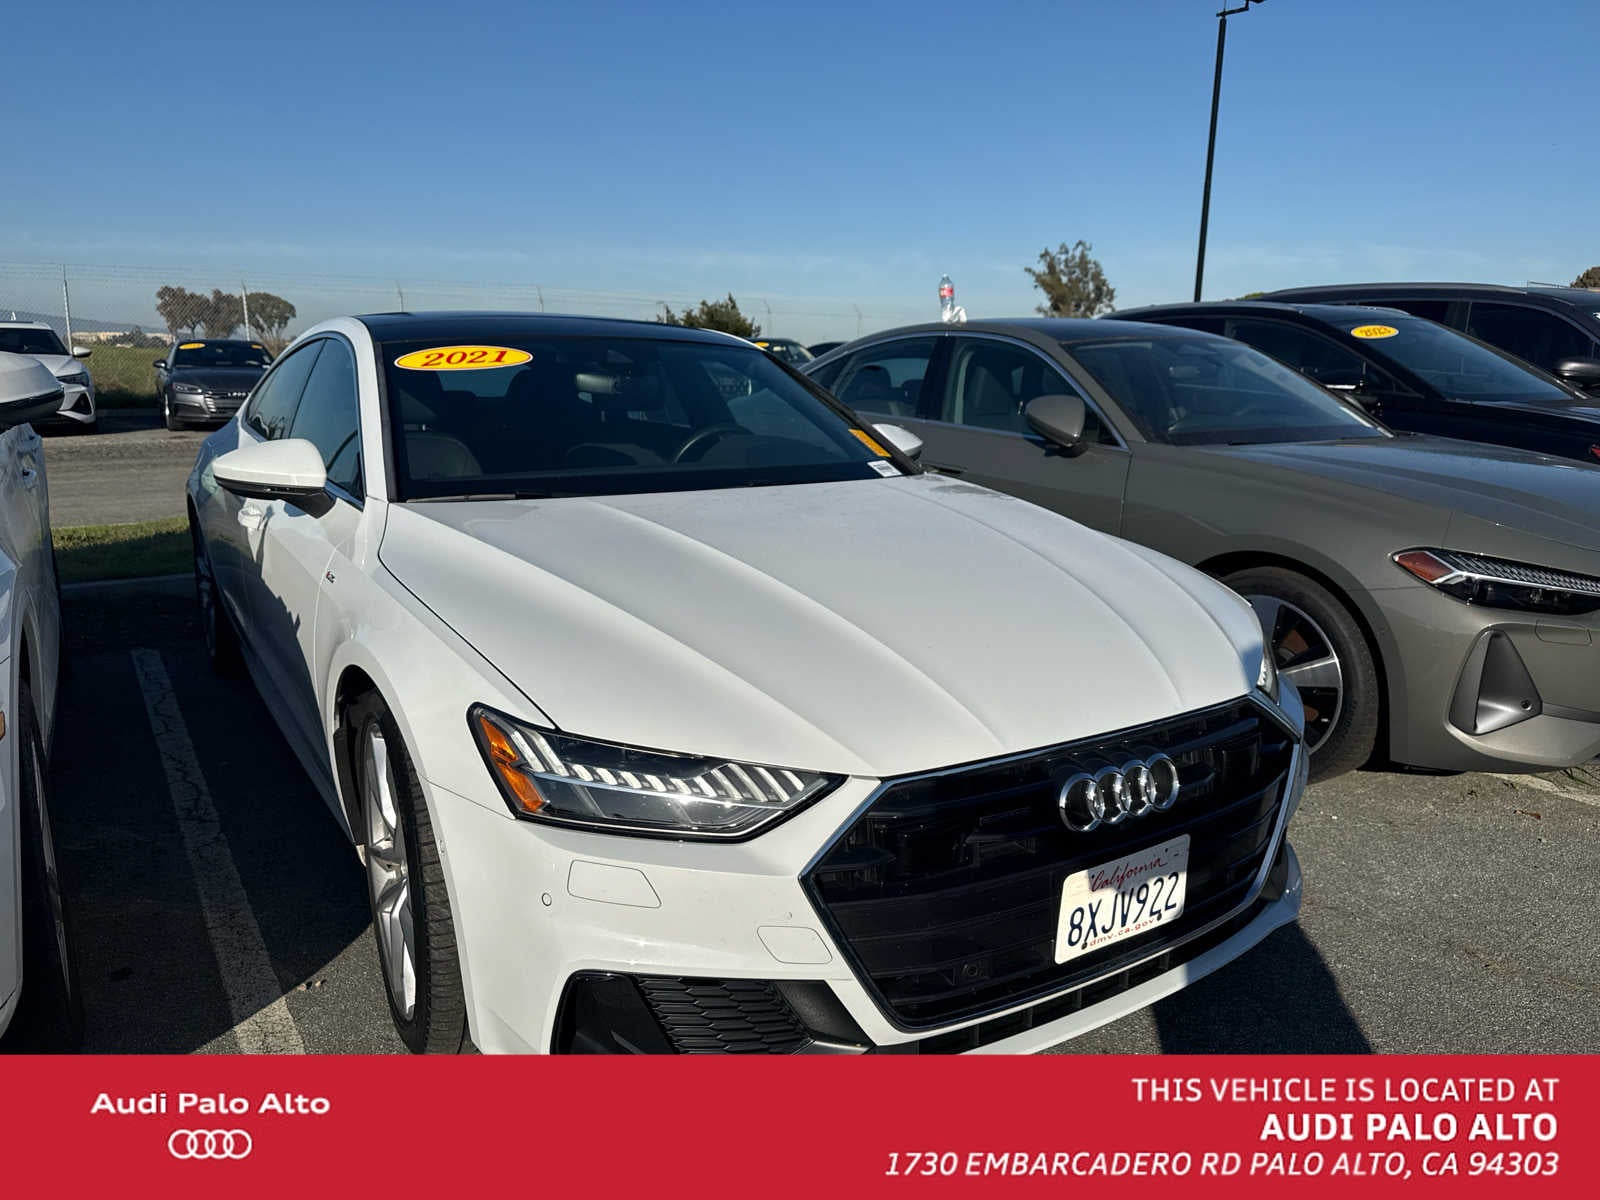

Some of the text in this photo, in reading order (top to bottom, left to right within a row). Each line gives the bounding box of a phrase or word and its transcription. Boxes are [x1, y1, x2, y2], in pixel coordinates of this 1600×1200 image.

[421, 350, 508, 367] 2021
[1091, 855, 1168, 893] California
[1067, 871, 1179, 947] 8XJV922
[1089, 917, 1155, 948] dmv.ca.gov
